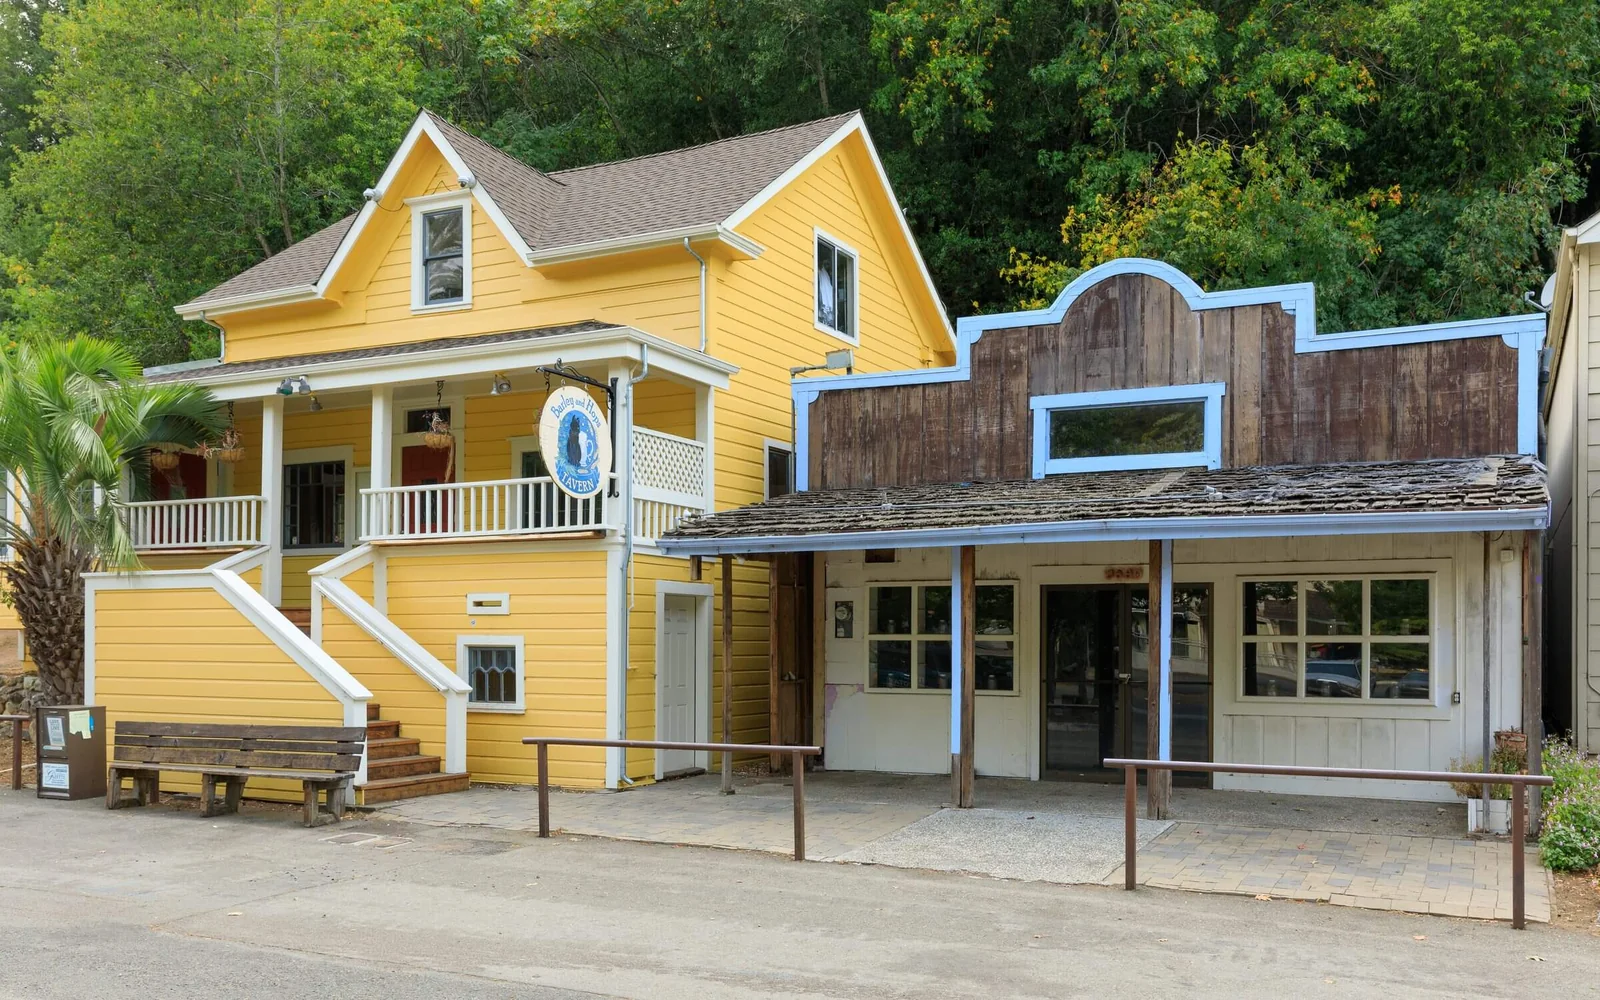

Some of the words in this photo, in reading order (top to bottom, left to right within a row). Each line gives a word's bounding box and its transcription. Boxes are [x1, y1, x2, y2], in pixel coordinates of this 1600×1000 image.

[550, 395, 574, 419] Barley
[575, 398, 585, 408] and
[585, 399, 602, 428] Hops
[561, 471, 594, 492] TAVERN
